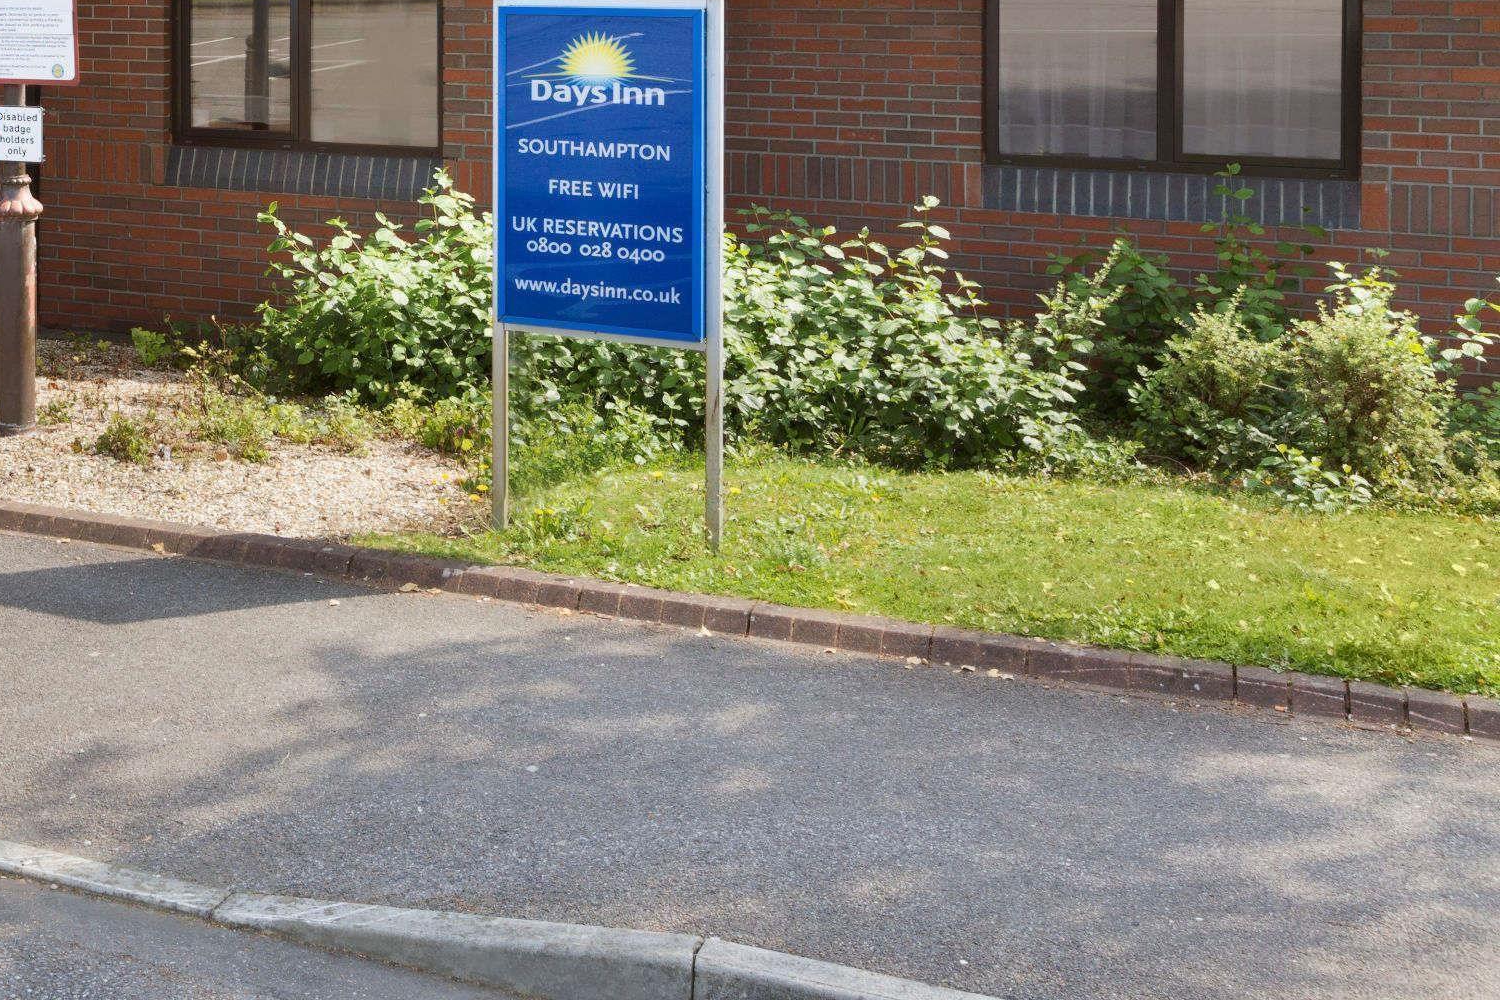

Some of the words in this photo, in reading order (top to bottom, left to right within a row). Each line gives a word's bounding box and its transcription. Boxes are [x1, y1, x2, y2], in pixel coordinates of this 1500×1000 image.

[531, 79, 607, 106] Days
[612, 82, 665, 106] Inn
[0, 136, 35, 144] holders
[3, 125, 31, 134] badge
[7, 147, 27, 157] only
[518, 138, 671, 161] SOUTHAMPTON
[548, 179, 593, 197] FREE
[598, 181, 639, 199] WIFI
[512, 216, 537, 232] UK
[543, 218, 683, 243] RESERVATIONS
[526, 237, 572, 255] 0800
[579, 242, 612, 258] 028
[617, 247, 665, 264] 0400
[514, 278, 681, 304] www.daysinn.co.uk
